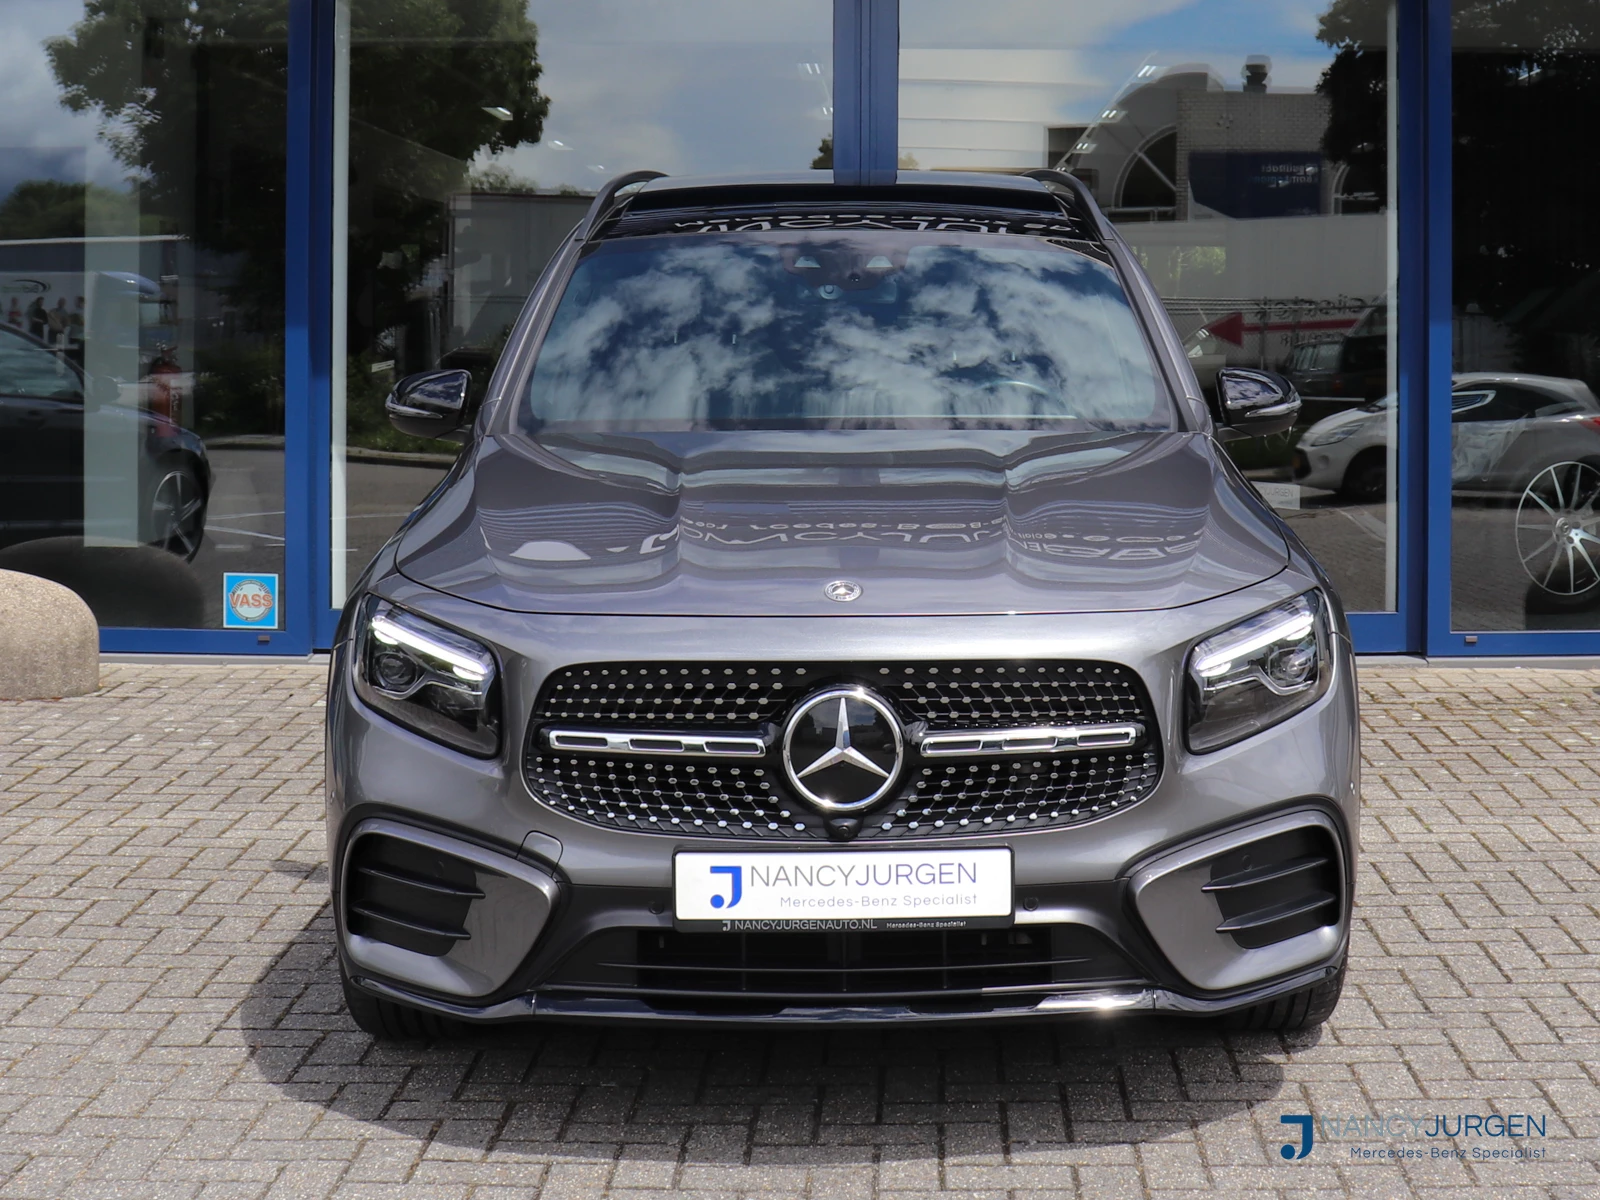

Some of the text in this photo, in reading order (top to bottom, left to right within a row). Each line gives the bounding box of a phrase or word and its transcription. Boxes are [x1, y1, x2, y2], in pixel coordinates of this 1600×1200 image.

[229, 593, 273, 608] VASS
[751, 862, 977, 887] NANCYJURGEN
[780, 893, 977, 908] Mercedes-Benz Specialist
[734, 919, 878, 931] NANCYJURGENAUTO.NL
